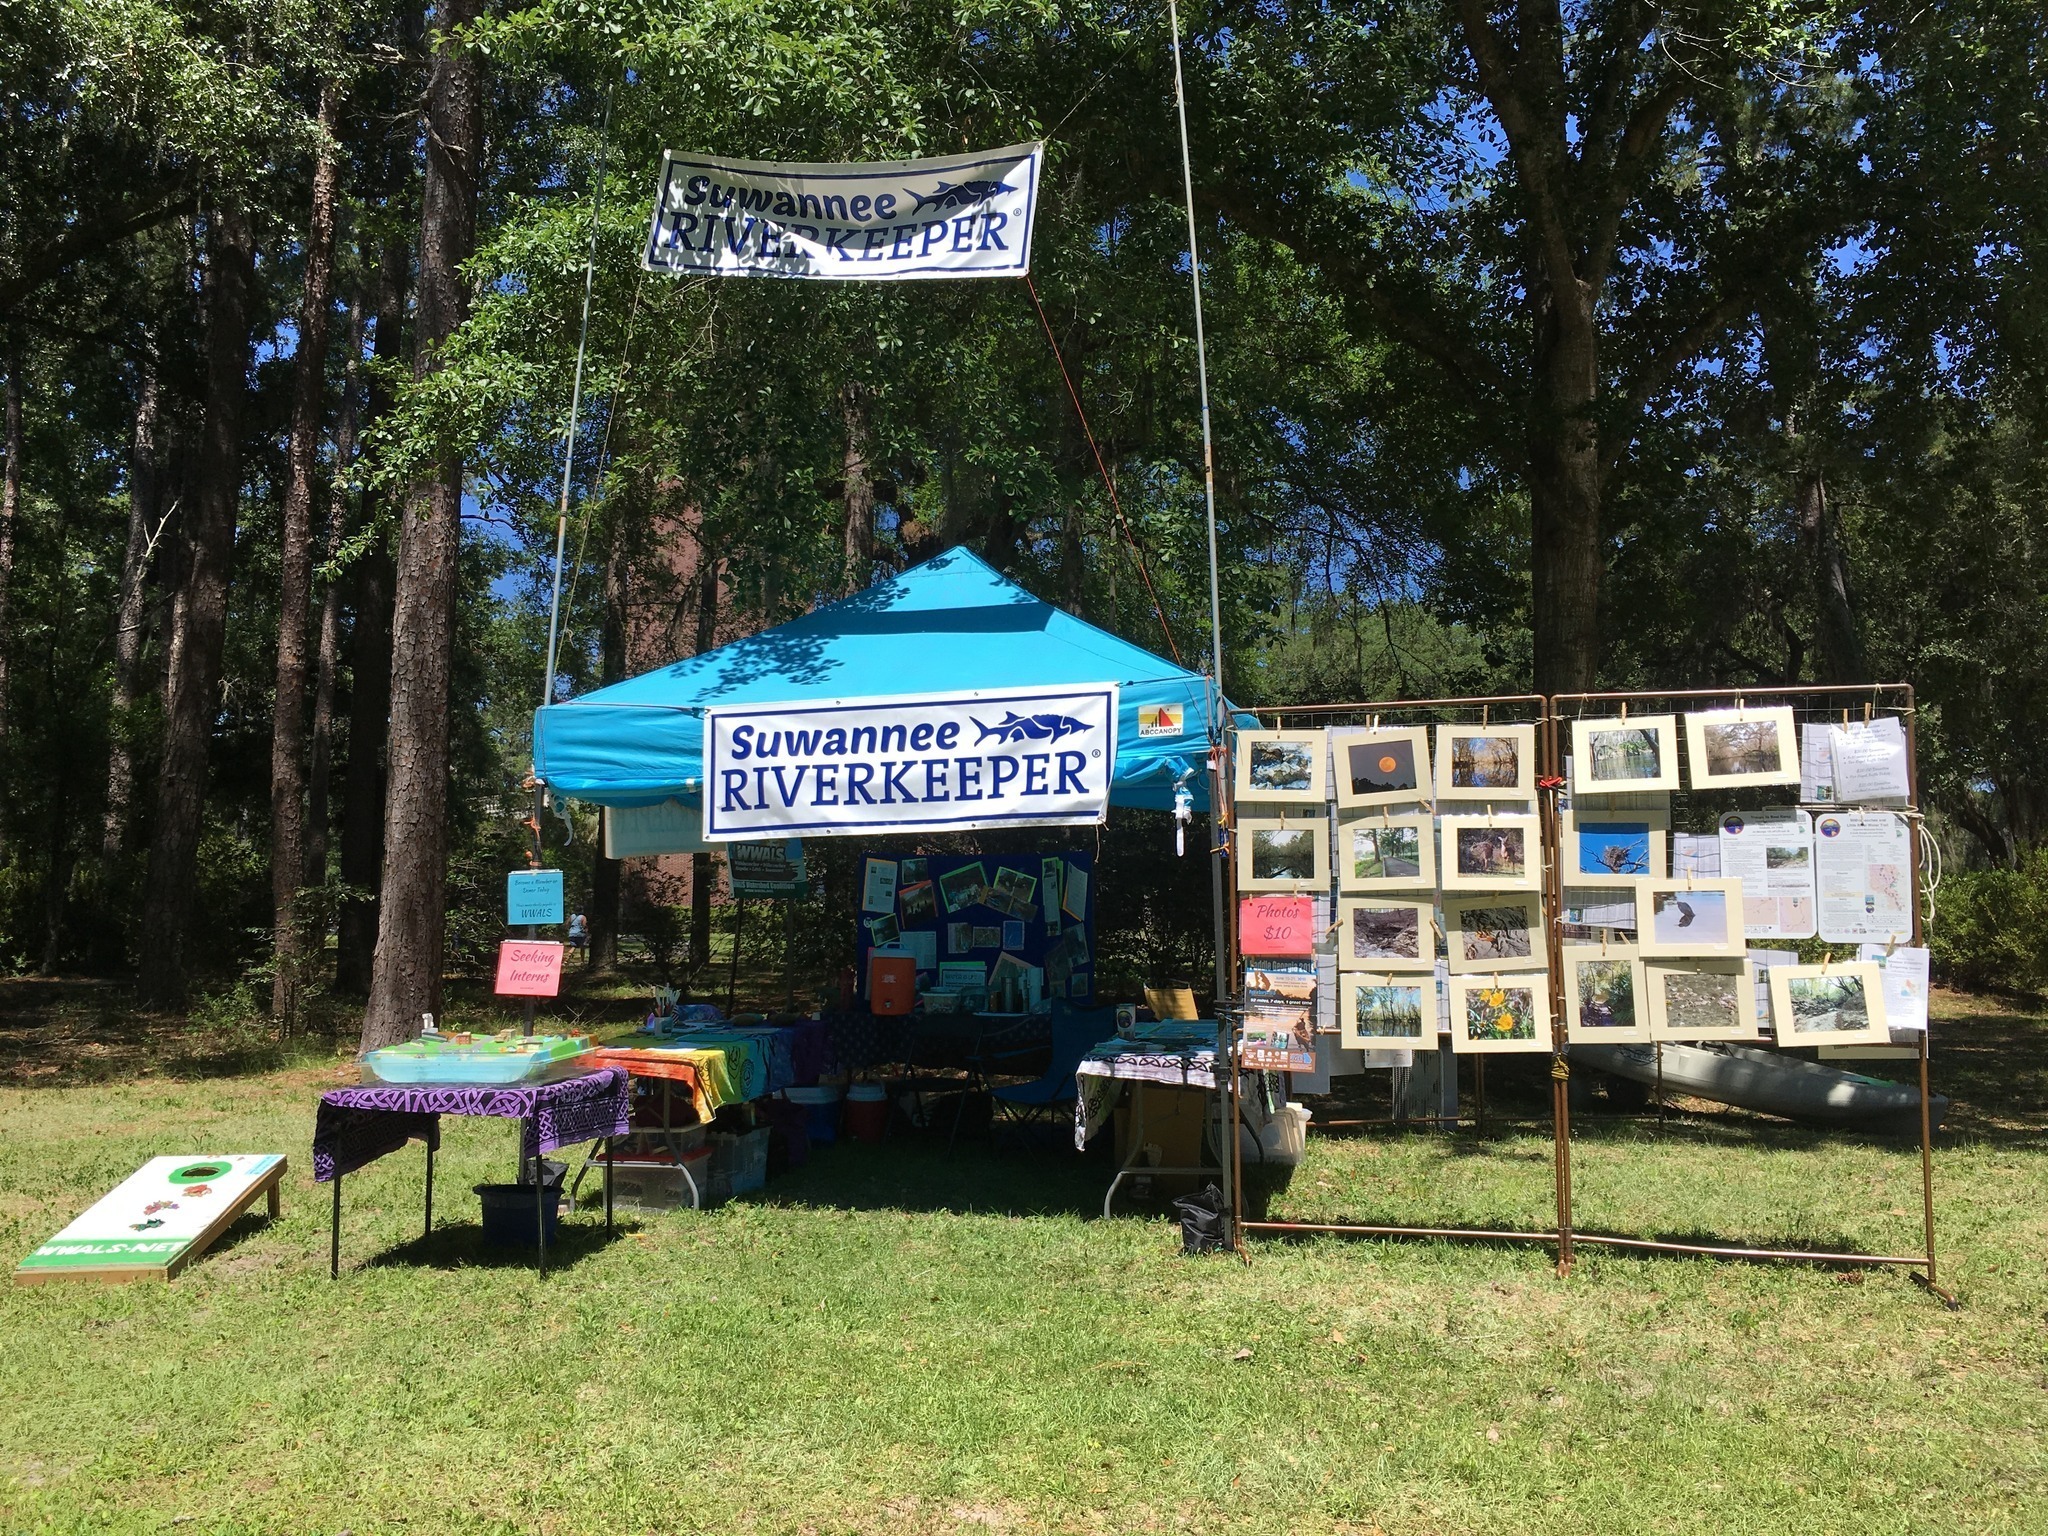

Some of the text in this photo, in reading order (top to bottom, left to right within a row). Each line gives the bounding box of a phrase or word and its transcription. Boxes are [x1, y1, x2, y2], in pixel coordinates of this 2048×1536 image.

[684, 175, 898, 221] Suwannee
[1140, 727, 1182, 736] ABCCANOPY
[731, 721, 961, 759] Suwannee
[737, 845, 786, 863] WWALS
[520, 908, 553, 918] WWALS
[1256, 904, 1300, 919] Photos
[1263, 925, 1292, 941] $10
[510, 949, 555, 967] Seeking
[510, 970, 550, 983] Interns
